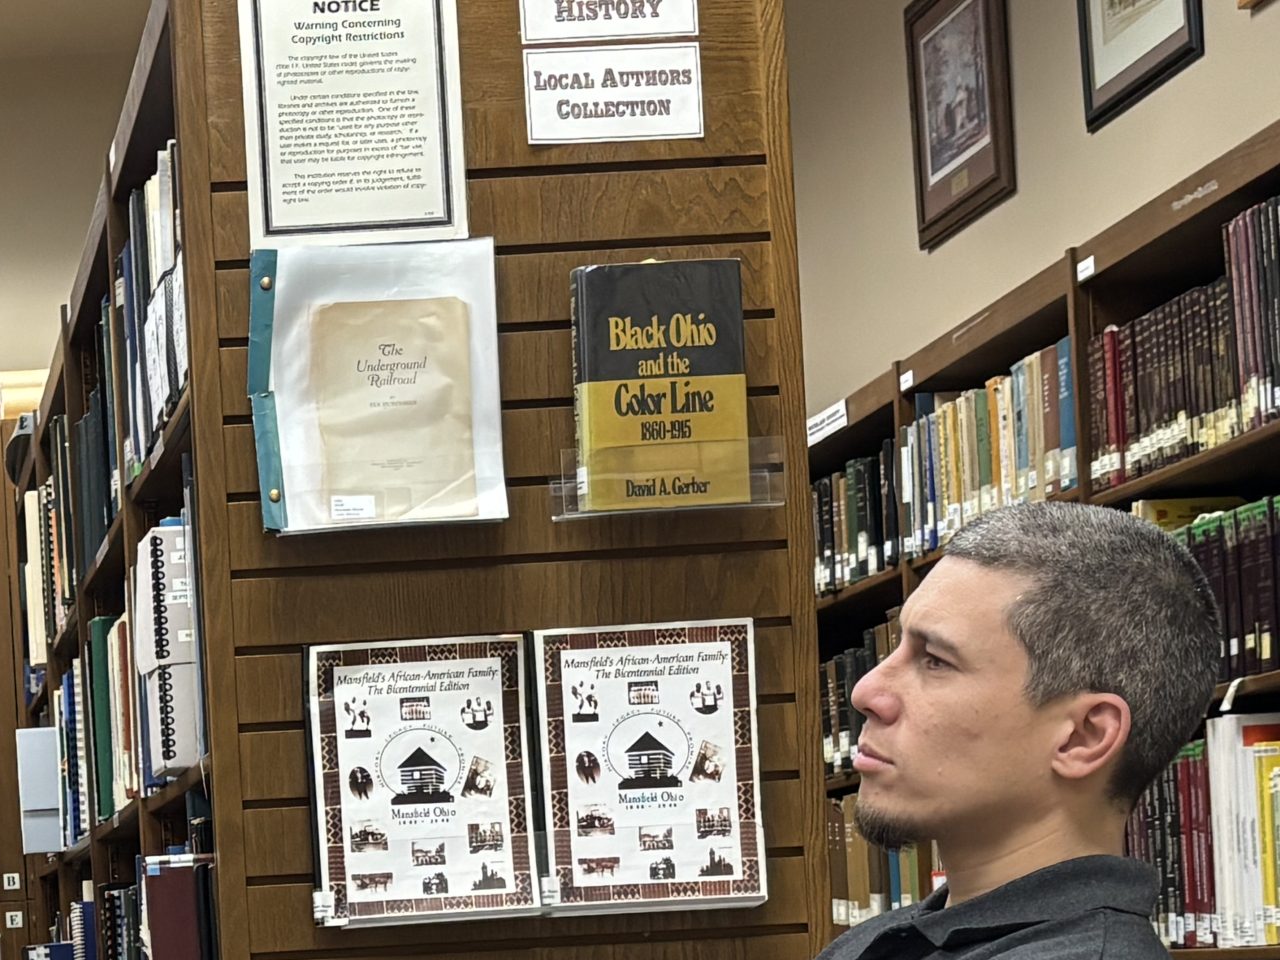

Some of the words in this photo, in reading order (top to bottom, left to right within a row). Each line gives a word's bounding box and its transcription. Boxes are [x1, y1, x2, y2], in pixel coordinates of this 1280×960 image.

[312, 0, 380, 14] NOTICE
[554, 0, 662, 22] HISTORY
[294, 21, 338, 32] Warning
[341, 18, 401, 30] Concerning
[291, 33, 342, 45] Copyright
[345, 30, 405, 42] Restrictions
[533, 70, 594, 91] LOCAL
[601, 68, 692, 88] AUTHORS
[556, 98, 672, 120] COLLECTION
[608, 314, 666, 351] Black
[670, 312, 717, 347] Ohio
[378, 344, 403, 356] The
[356, 356, 427, 373] Underground
[638, 352, 664, 376] and
[667, 351, 690, 374] the
[368, 370, 417, 388] Railroad
[614, 383, 666, 417] Color
[670, 380, 714, 414] Line
[640, 418, 692, 441] 1860-1915
[626, 478, 656, 498] David
[658, 477, 672, 496] A.
[672, 476, 711, 495] Gerber
[564, 656, 614, 669] Mansfield's
[616, 652, 694, 666] African-American
[336, 672, 386, 687] Mansfield's
[388, 669, 464, 684] African-American
[595, 669, 611, 680] The
[614, 666, 666, 678] Bicentennial
[668, 666, 699, 676] Edition
[368, 685, 384, 696] The
[386, 682, 437, 694] Bicentennial
[440, 682, 470, 692] Edition
[618, 793, 658, 804] Mansfield
[661, 791, 684, 802] Ohio
[392, 808, 430, 820] Mansfield
[433, 806, 456, 818] Ohio
[7, 876, 16, 886] B
[10, 914, 19, 926] E
